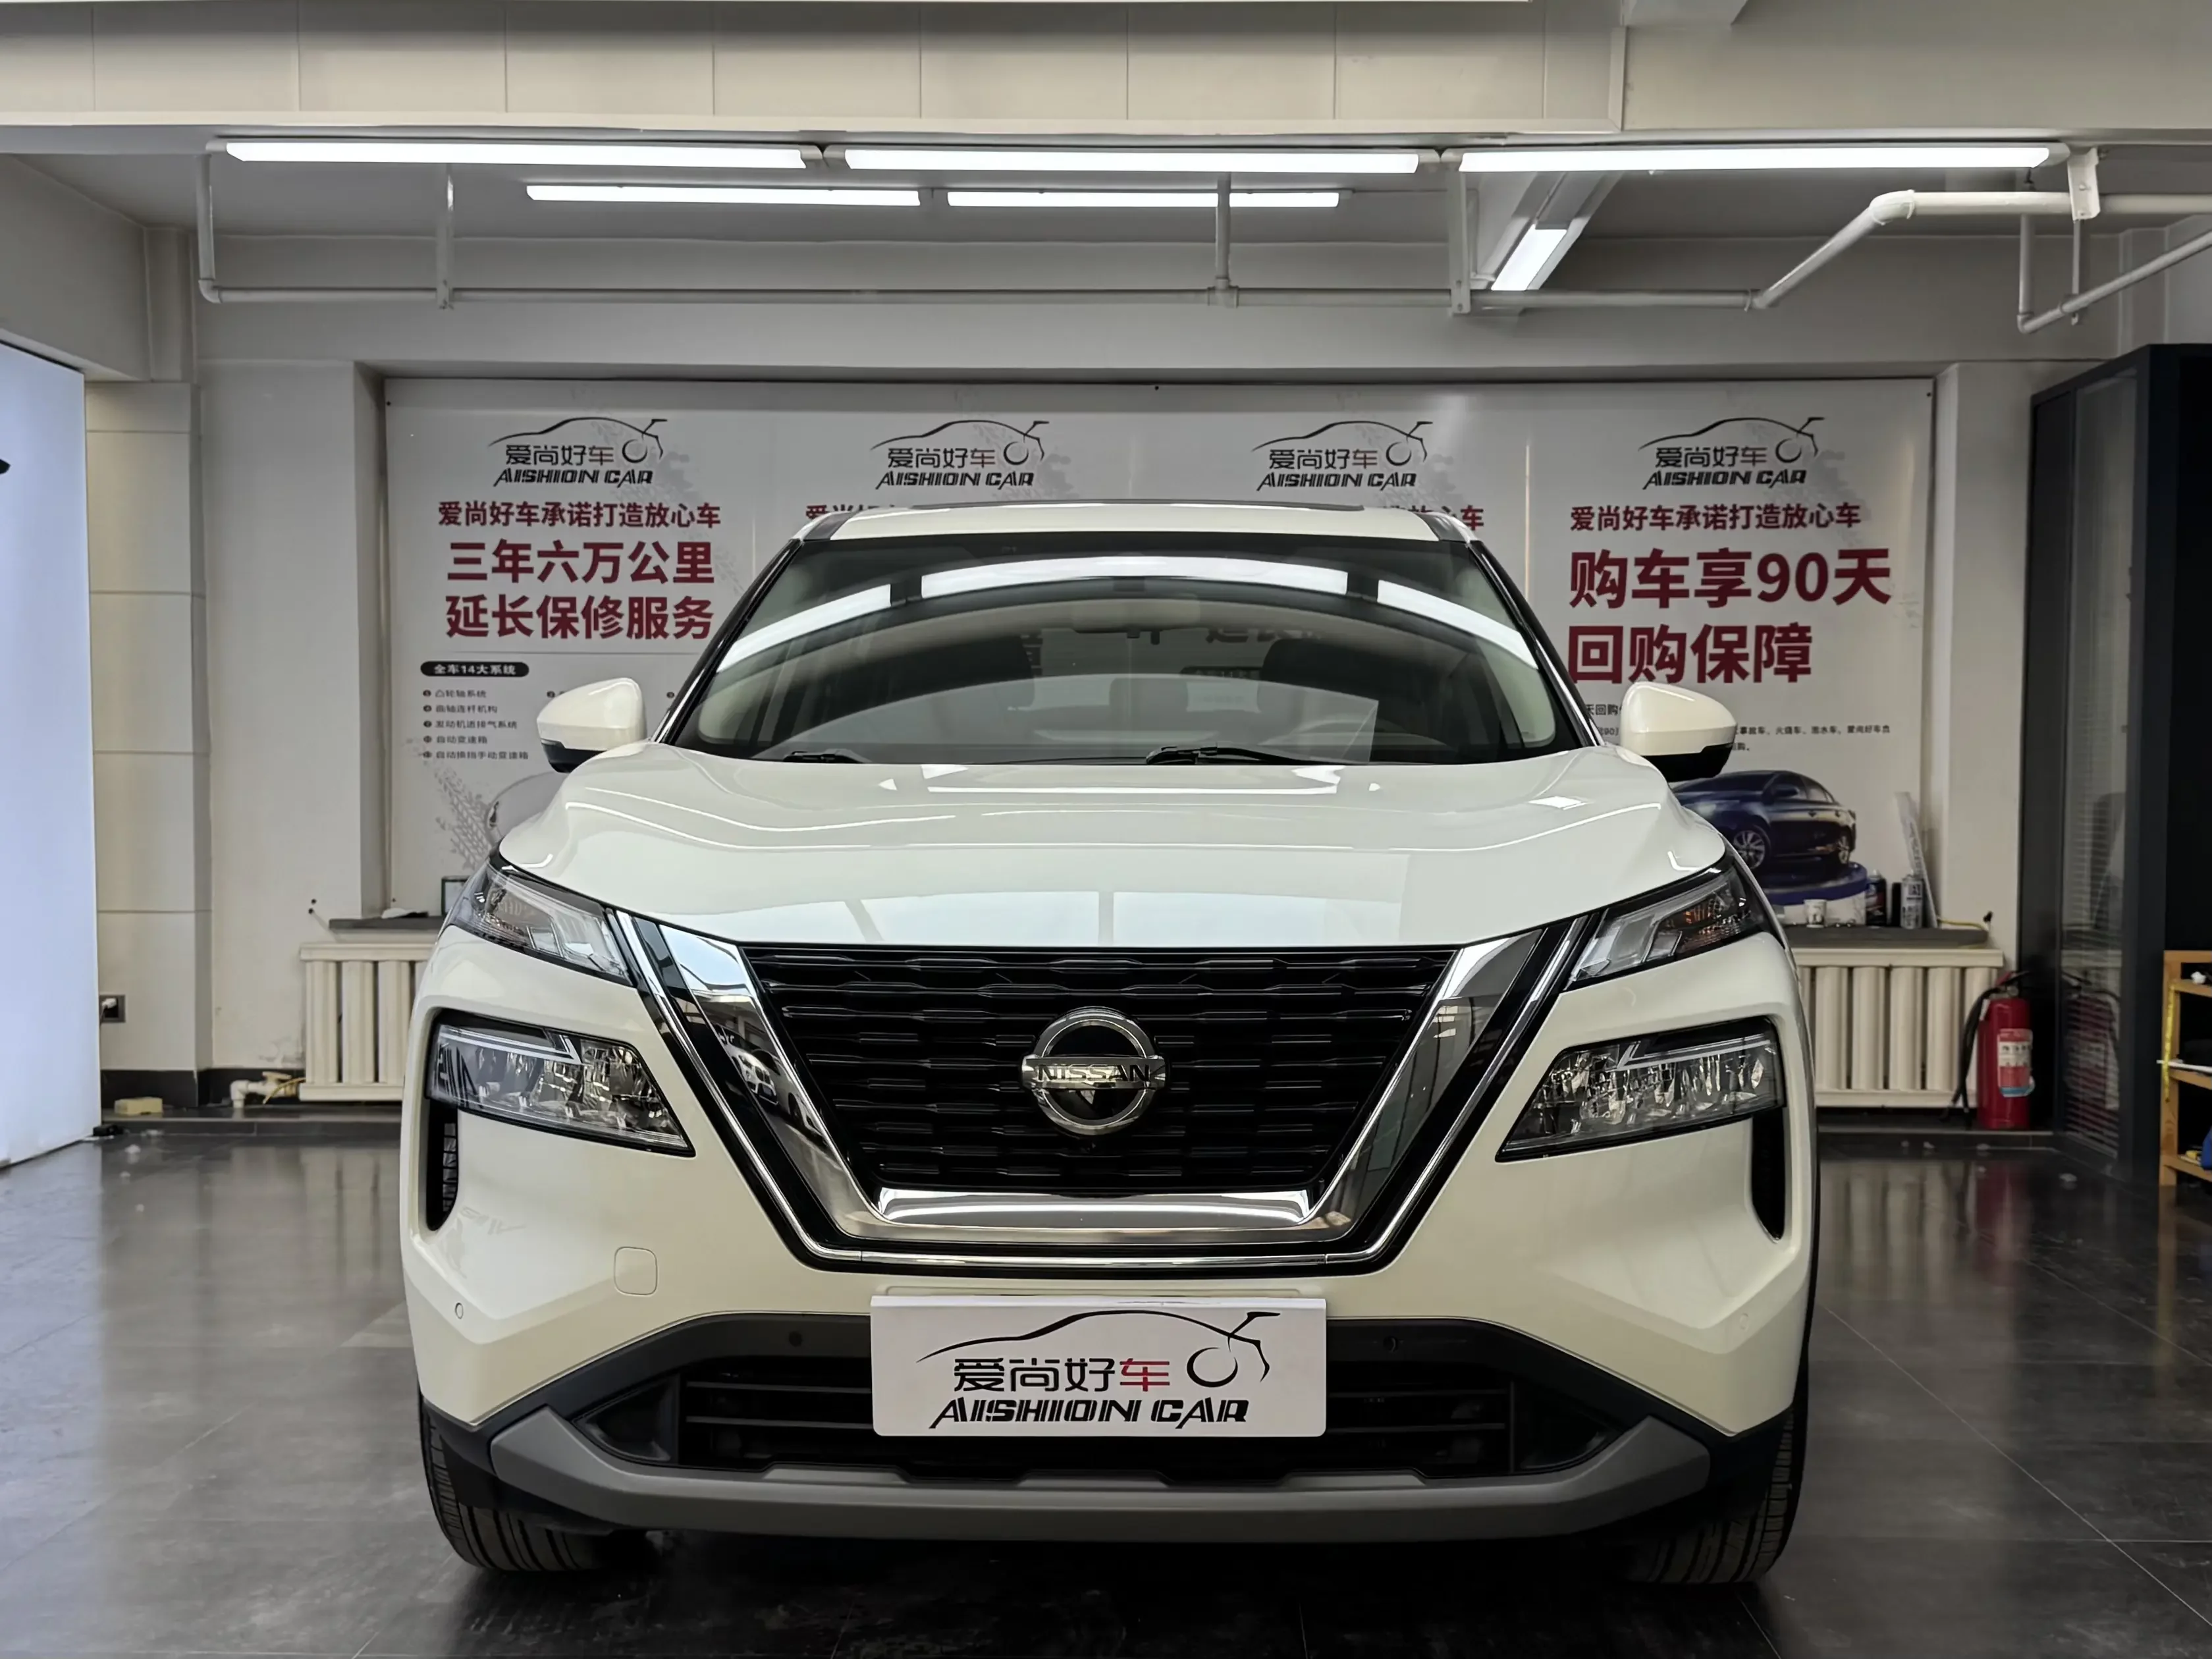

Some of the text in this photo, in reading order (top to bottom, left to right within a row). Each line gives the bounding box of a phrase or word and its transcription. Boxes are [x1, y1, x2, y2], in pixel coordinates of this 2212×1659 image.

[506, 445, 614, 466] 爱尚好车
[888, 448, 996, 468] 爱尚好车
[1270, 449, 1378, 470] 爱尚好车
[1656, 446, 1767, 468] 爱尚好车
[493, 468, 653, 488] AISHION CAR
[875, 471, 1034, 490] AISHION CAR
[1256, 472, 1416, 491] AISHION CAR
[1643, 469, 1807, 489] AISHION CAR
[438, 501, 722, 529] 爱尚好车承诺打造放心车
[1570, 502, 1862, 531] 爱尚好车承诺打造放心车
[447, 538, 715, 584] 三年六万公里
[1569, 547, 1892, 609] 购车享90天
[445, 594, 715, 640] 延长保修服务
[1567, 622, 1813, 684] 回购保障
[434, 663, 516, 676] 全车14大系统
[1037, 1063, 1150, 1082] NISSAN
[954, 1357, 1170, 1392] 爱尚好车
[929, 1396, 1249, 1430] AISHION CAR
